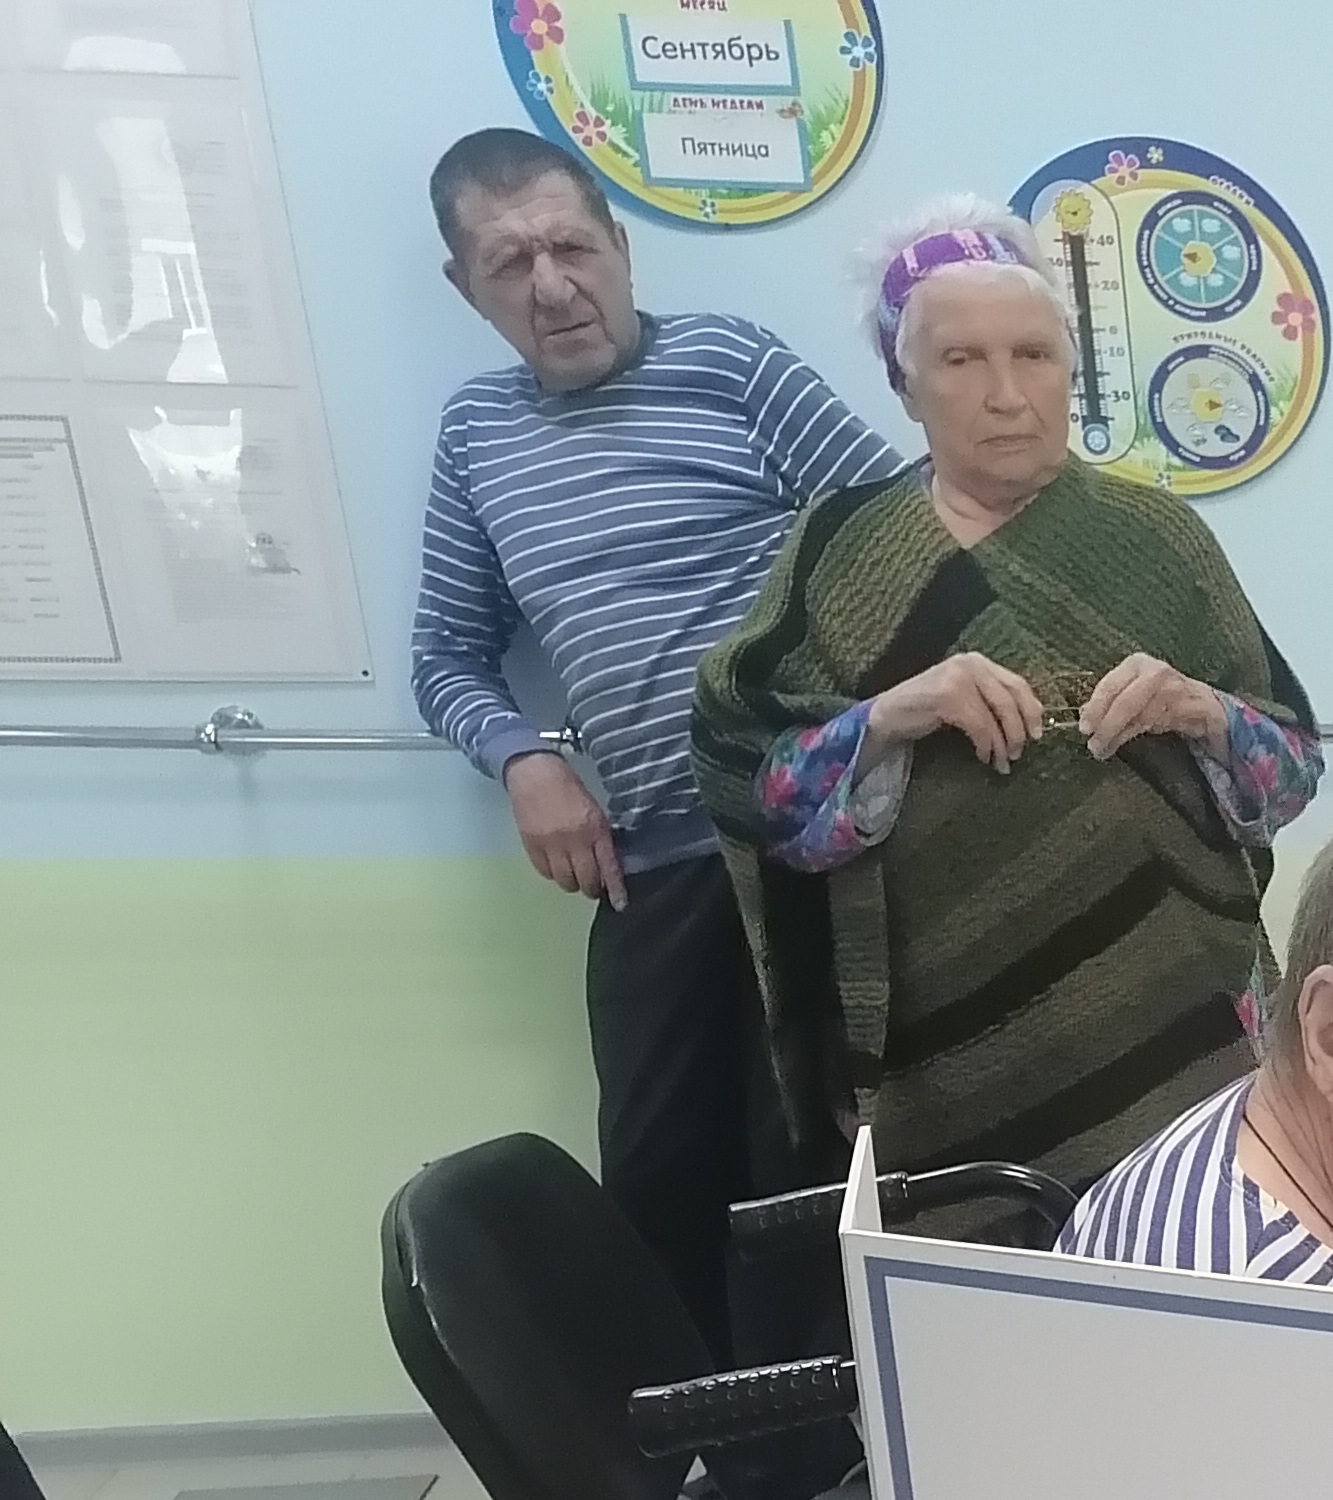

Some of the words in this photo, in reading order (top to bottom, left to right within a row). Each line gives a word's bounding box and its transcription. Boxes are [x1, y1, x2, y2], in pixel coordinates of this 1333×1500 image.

[641, 36, 780, 66] Сентябрь
[673, 98, 707, 108] ДЕНЬ
[711, 98, 764, 110] НЕДЕЛИ
[680, 137, 770, 159] Пятница
[1088, 234, 1114, 246] +40
[1094, 280, 1120, 291] +20
[1110, 324, 1118, 334] 0
[1103, 346, 1125, 358] -10
[1107, 390, 1130, 402] -30
